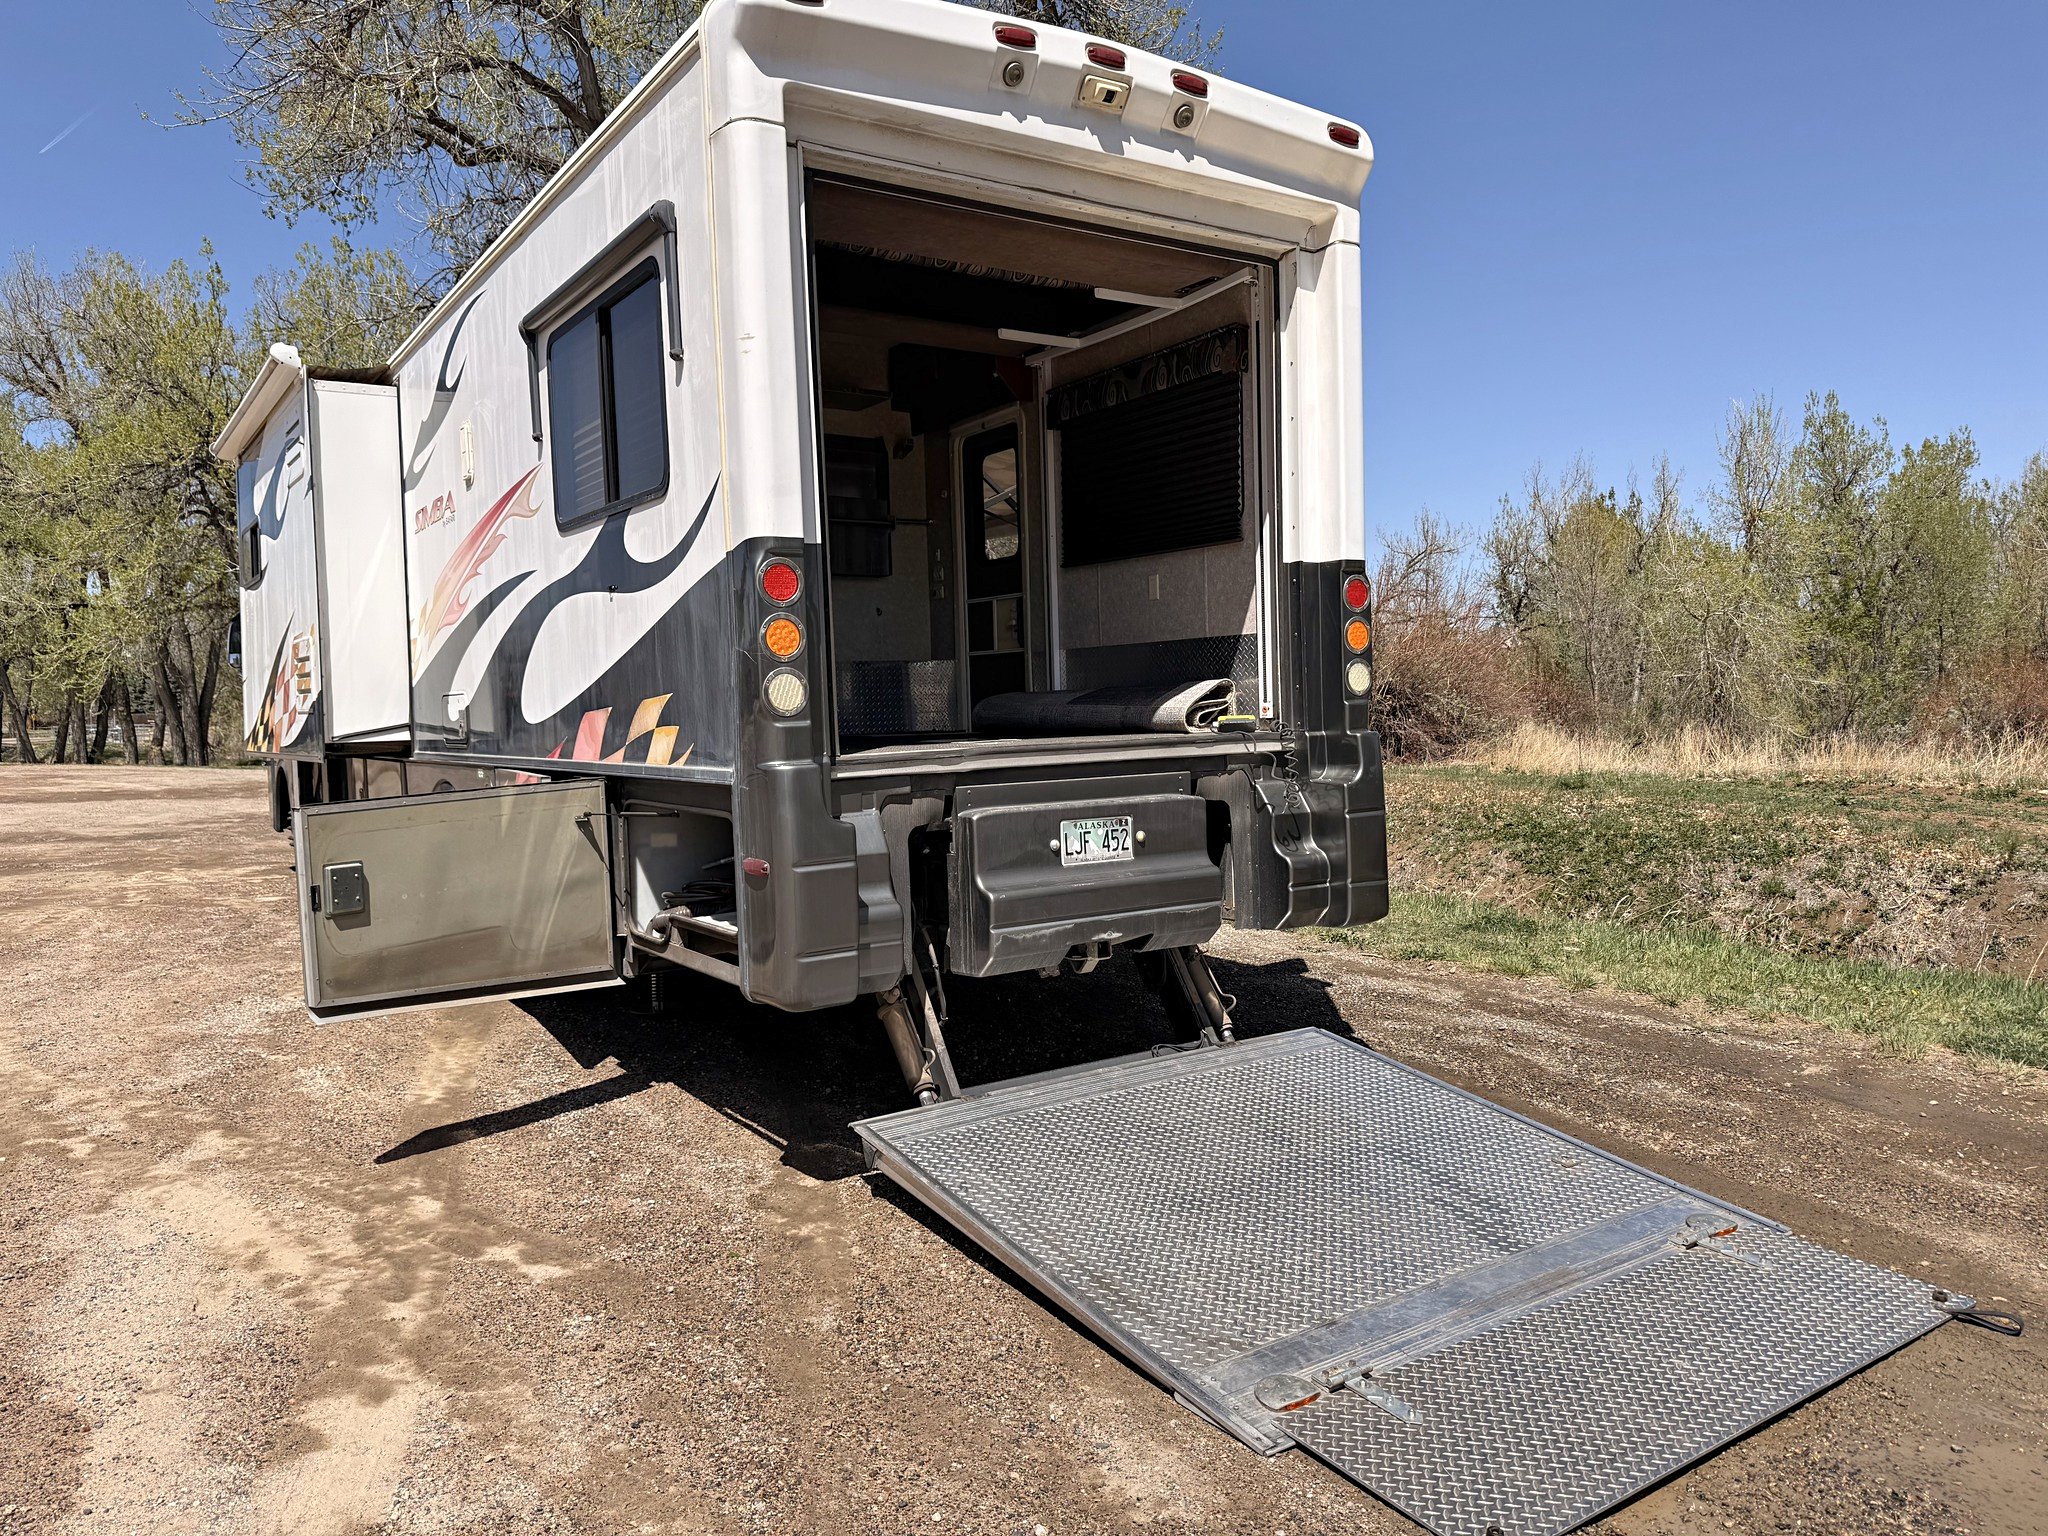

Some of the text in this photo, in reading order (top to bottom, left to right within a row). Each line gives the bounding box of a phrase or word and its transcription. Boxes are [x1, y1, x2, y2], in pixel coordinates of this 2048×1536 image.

[1078, 820, 1115, 830] ALASKA
[1065, 828, 1129, 856] LJF 452
